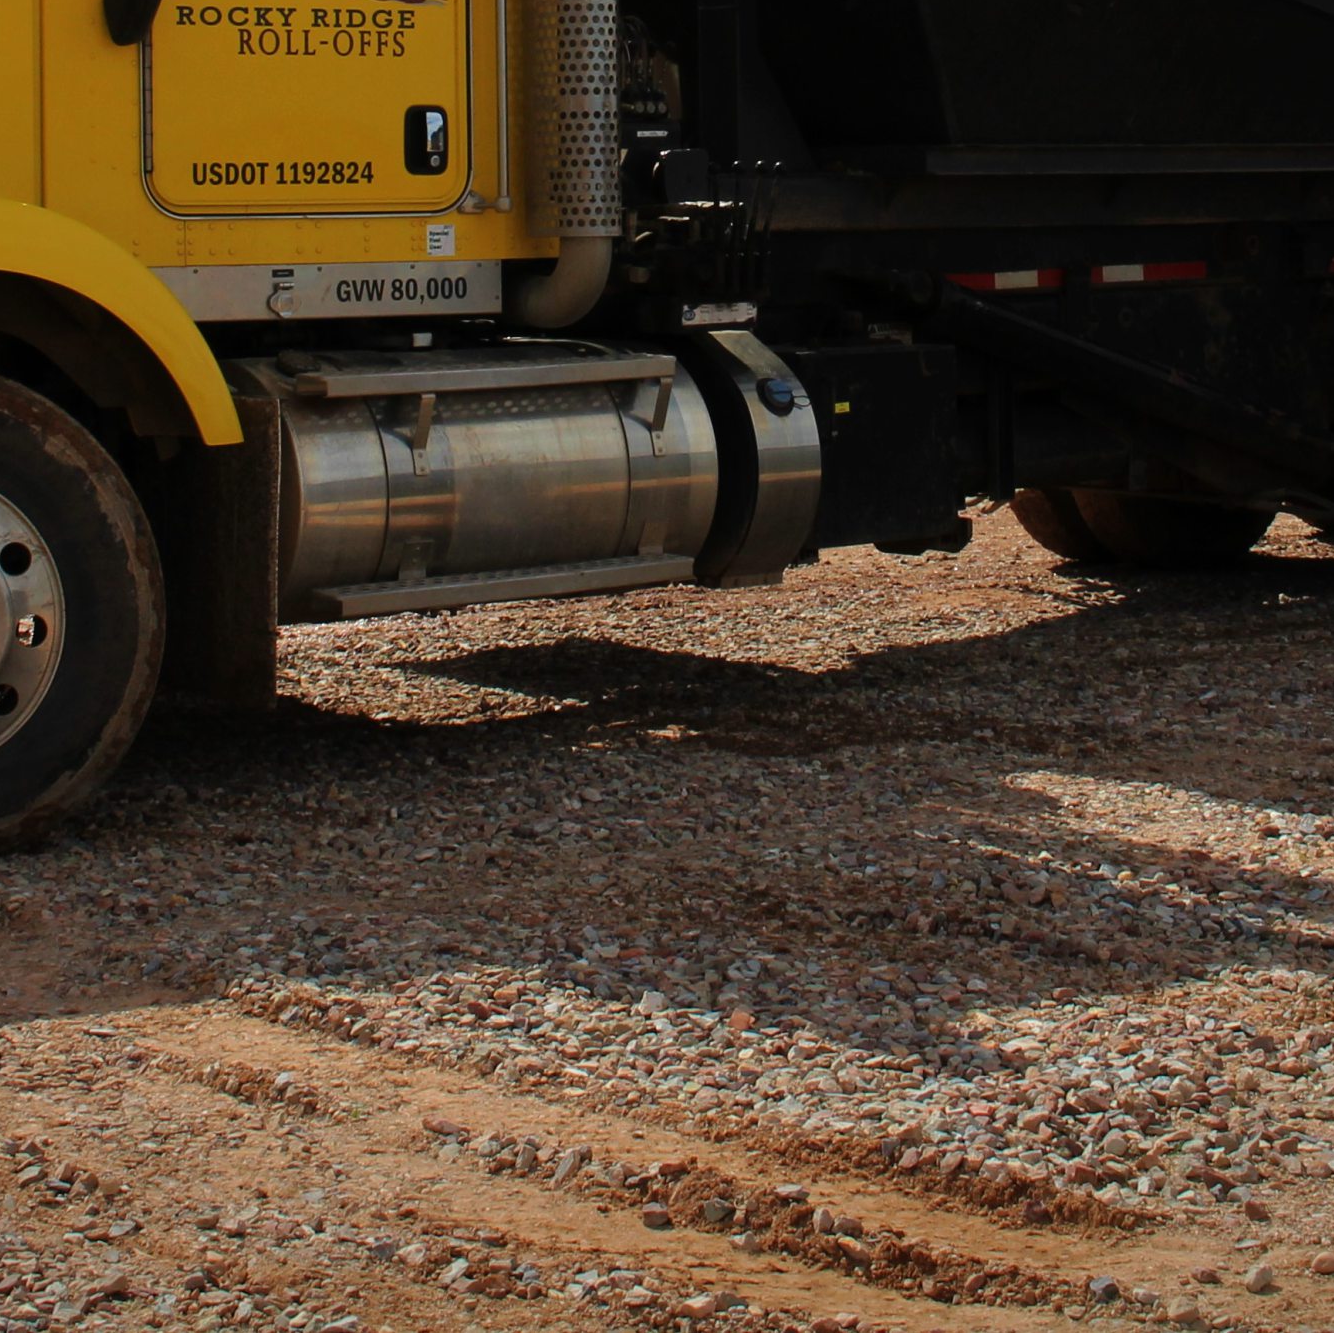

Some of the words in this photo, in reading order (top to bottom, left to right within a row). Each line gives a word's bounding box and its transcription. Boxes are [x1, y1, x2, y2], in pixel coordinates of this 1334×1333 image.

[176, 6, 297, 26] ROCKY
[311, 9, 416, 29] RIDGE
[238, 28, 405, 57] ROLL-OFFS
[192, 162, 269, 185] USDOT
[276, 161, 374, 184] 1192824
[336, 279, 385, 303] GVW
[390, 276, 468, 304] 80,000
